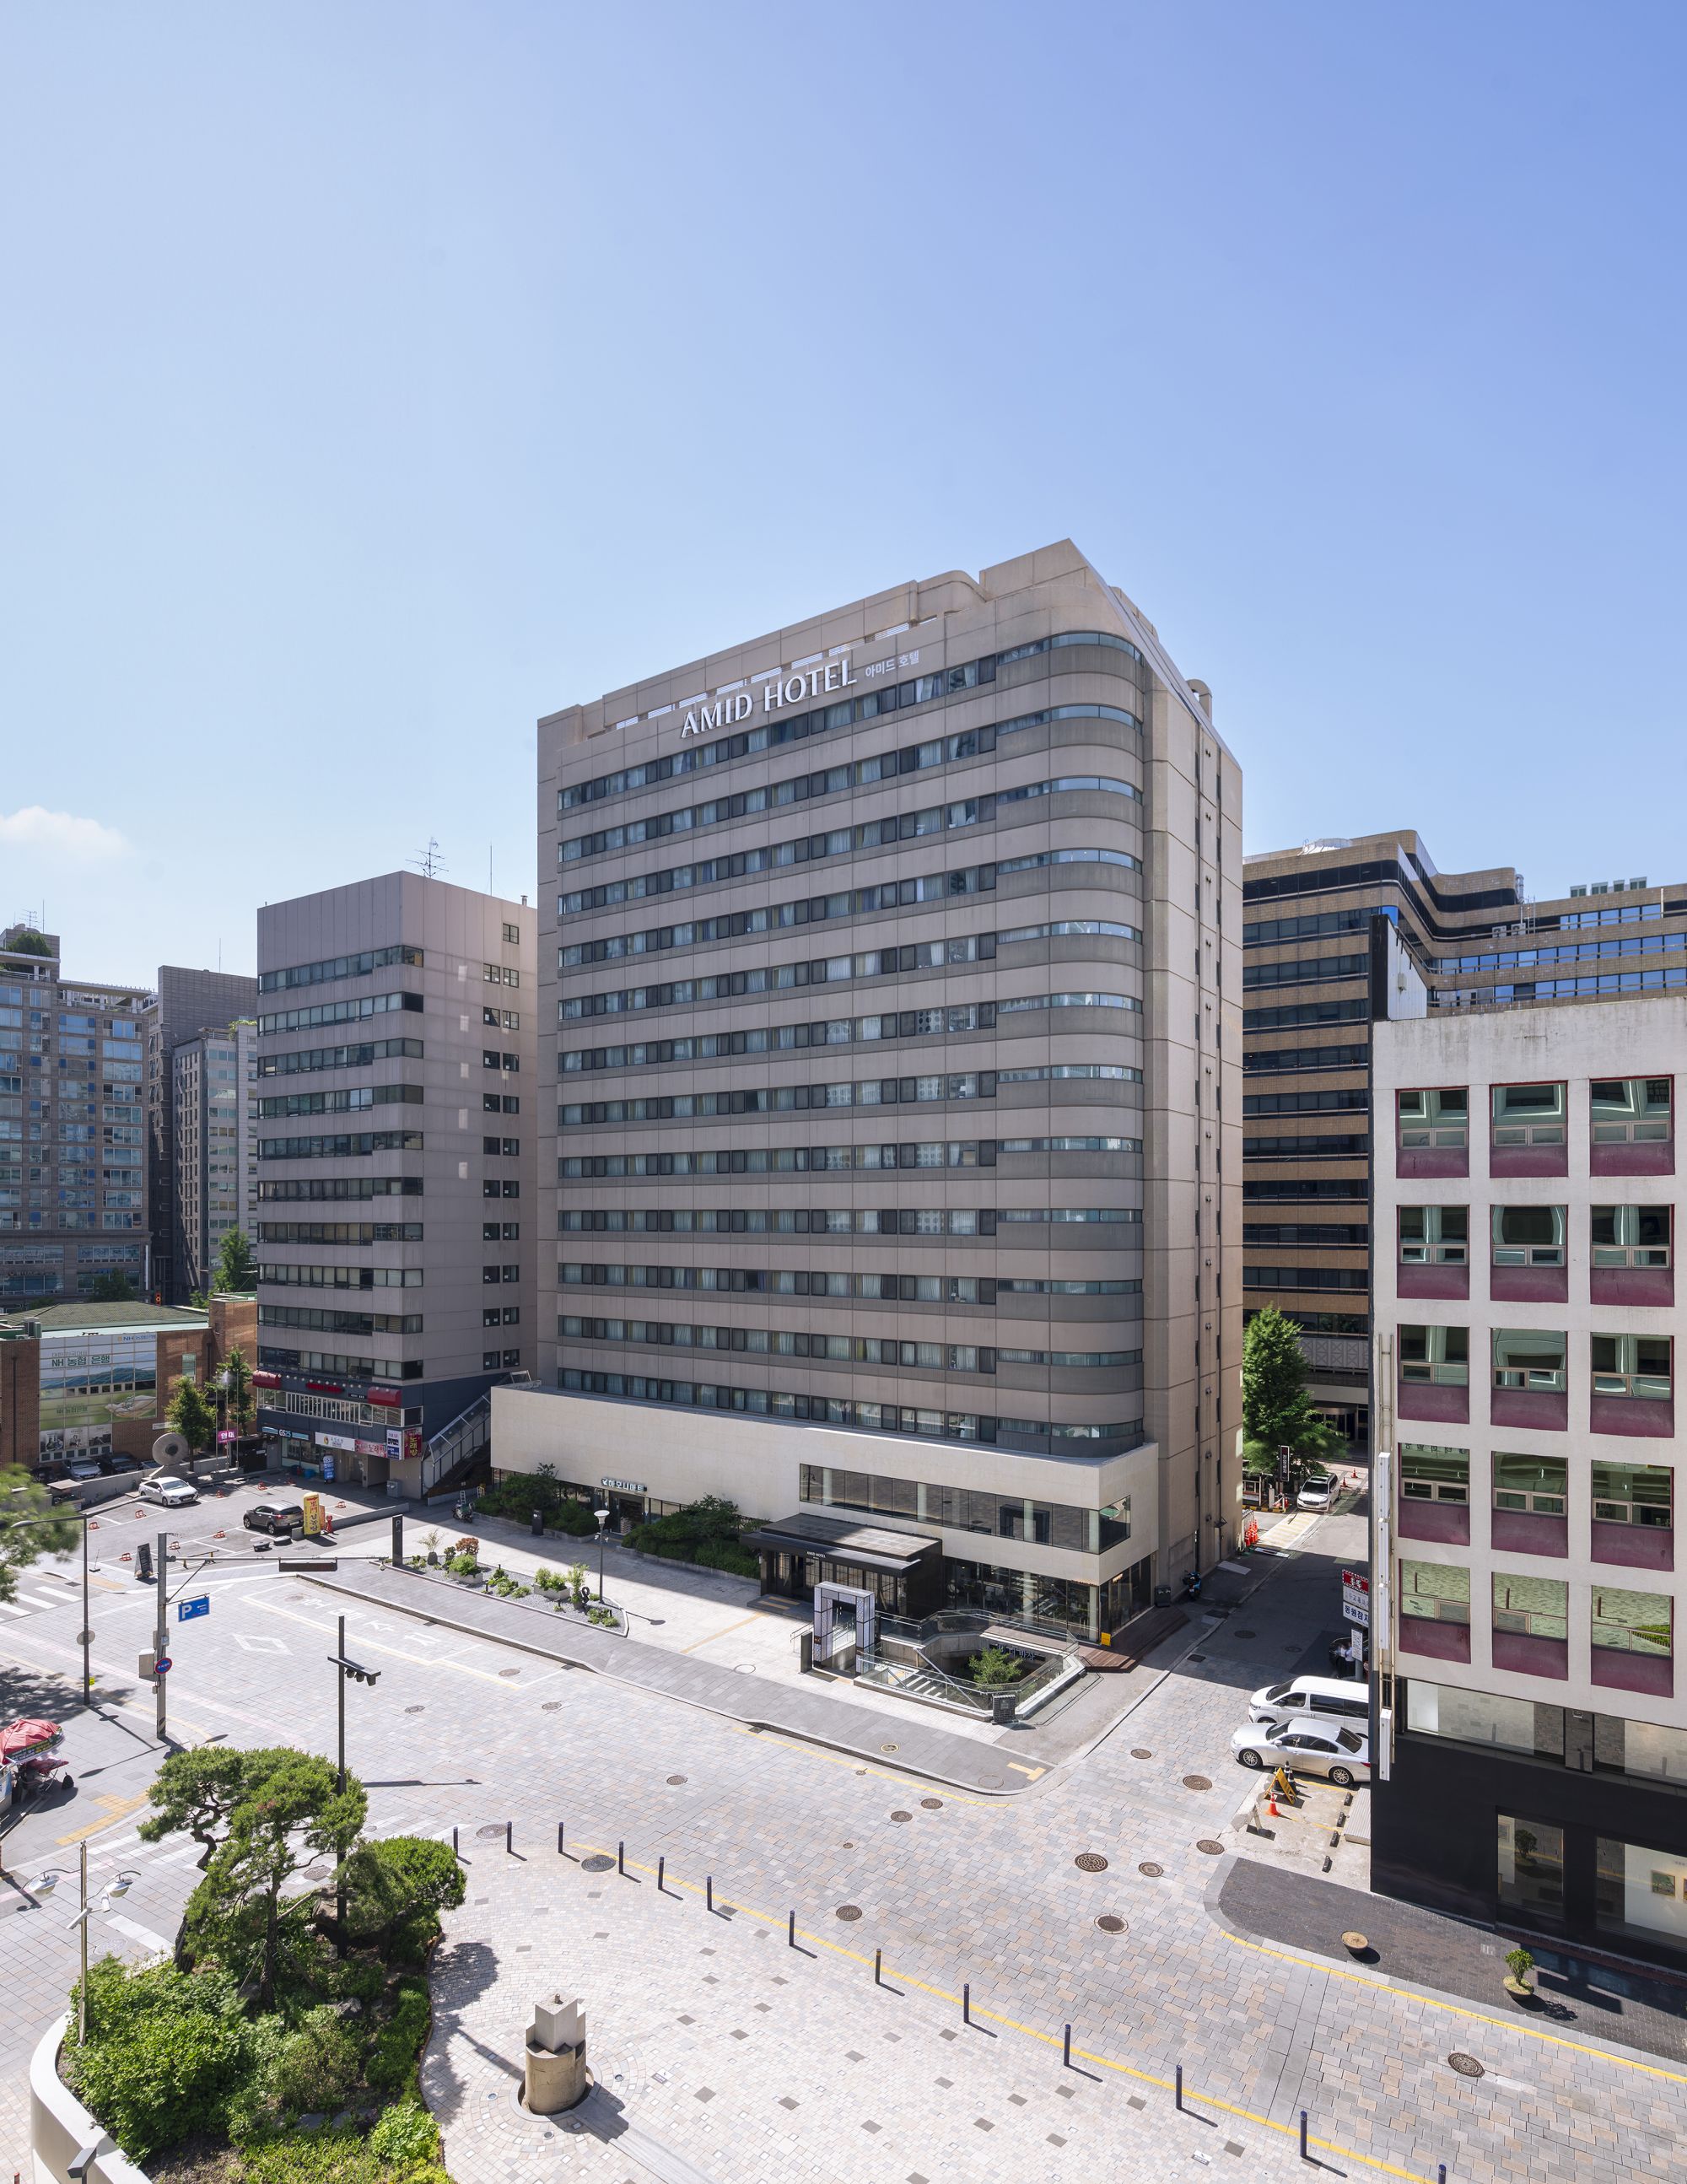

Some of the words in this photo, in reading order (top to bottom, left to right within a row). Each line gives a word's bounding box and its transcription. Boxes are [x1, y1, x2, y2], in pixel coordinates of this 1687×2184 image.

[865, 661, 896, 678] 아미드
[898, 650, 919, 668] 호텔
[680, 693, 753, 738] AMID
[764, 659, 858, 712] HOTEL
[67, 1356, 87, 1366] 농협
[91, 1355, 110, 1365] 은행
[181, 1604, 192, 1619] P
